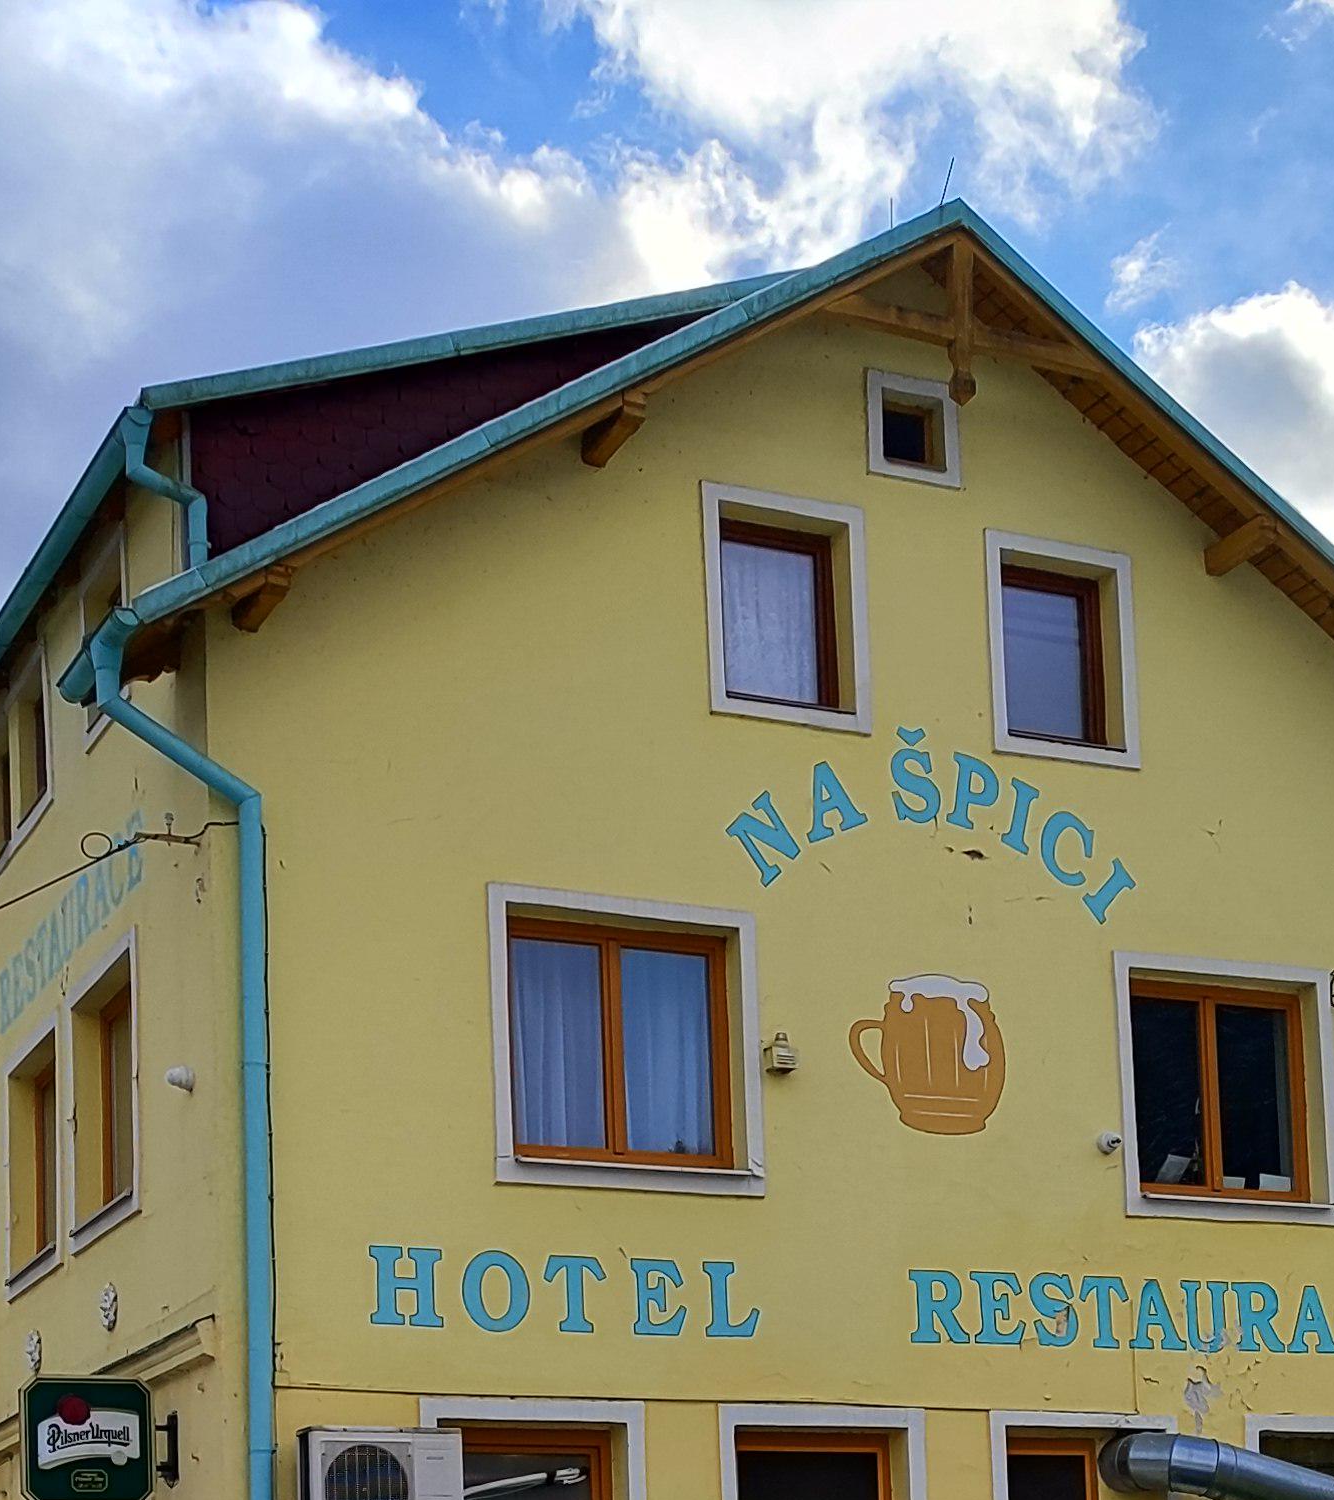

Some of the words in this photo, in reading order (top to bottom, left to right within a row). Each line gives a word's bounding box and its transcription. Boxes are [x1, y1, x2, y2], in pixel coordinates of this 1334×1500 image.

[724, 759, 869, 889] NA
[888, 725, 1137, 926] ŠPICI
[367, 1243, 762, 1339] HOTEL
[46, 1423, 91, 1453] Pilsner
[89, 1421, 130, 1447] Urquell
